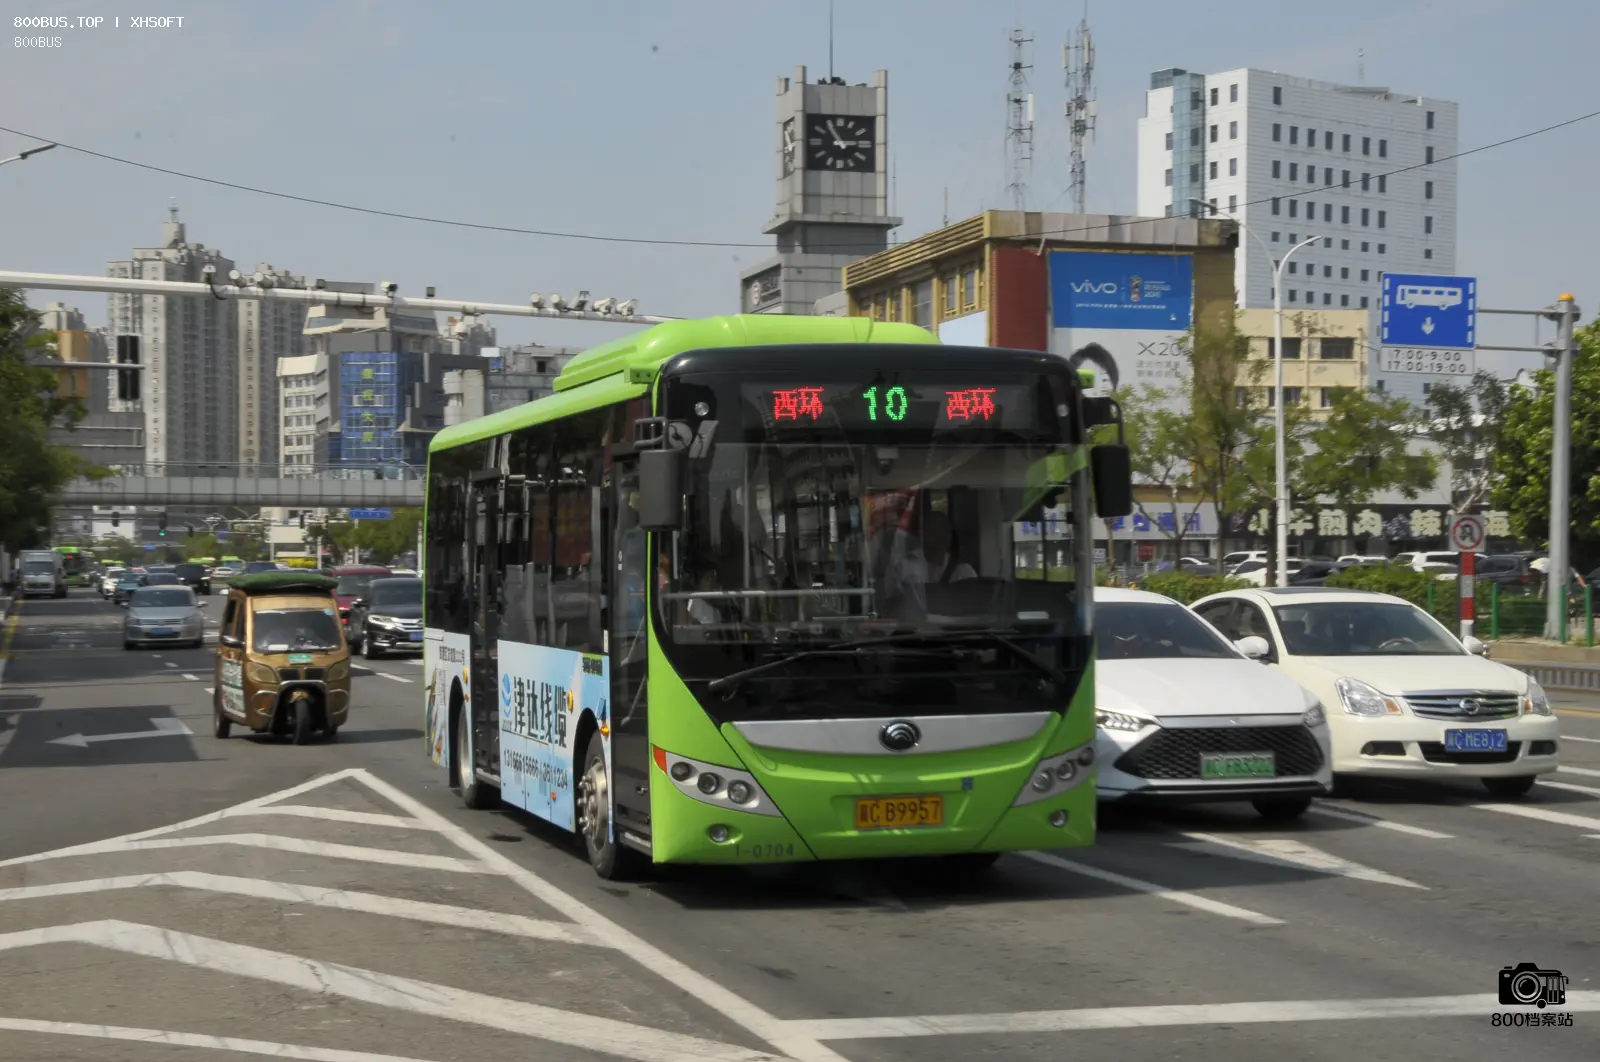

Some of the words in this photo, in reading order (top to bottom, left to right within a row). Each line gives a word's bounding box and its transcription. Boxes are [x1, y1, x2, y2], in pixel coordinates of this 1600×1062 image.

[773, 386, 824, 420] 西环
[863, 386, 908, 421] 10
[946, 387, 996, 420] 西环
